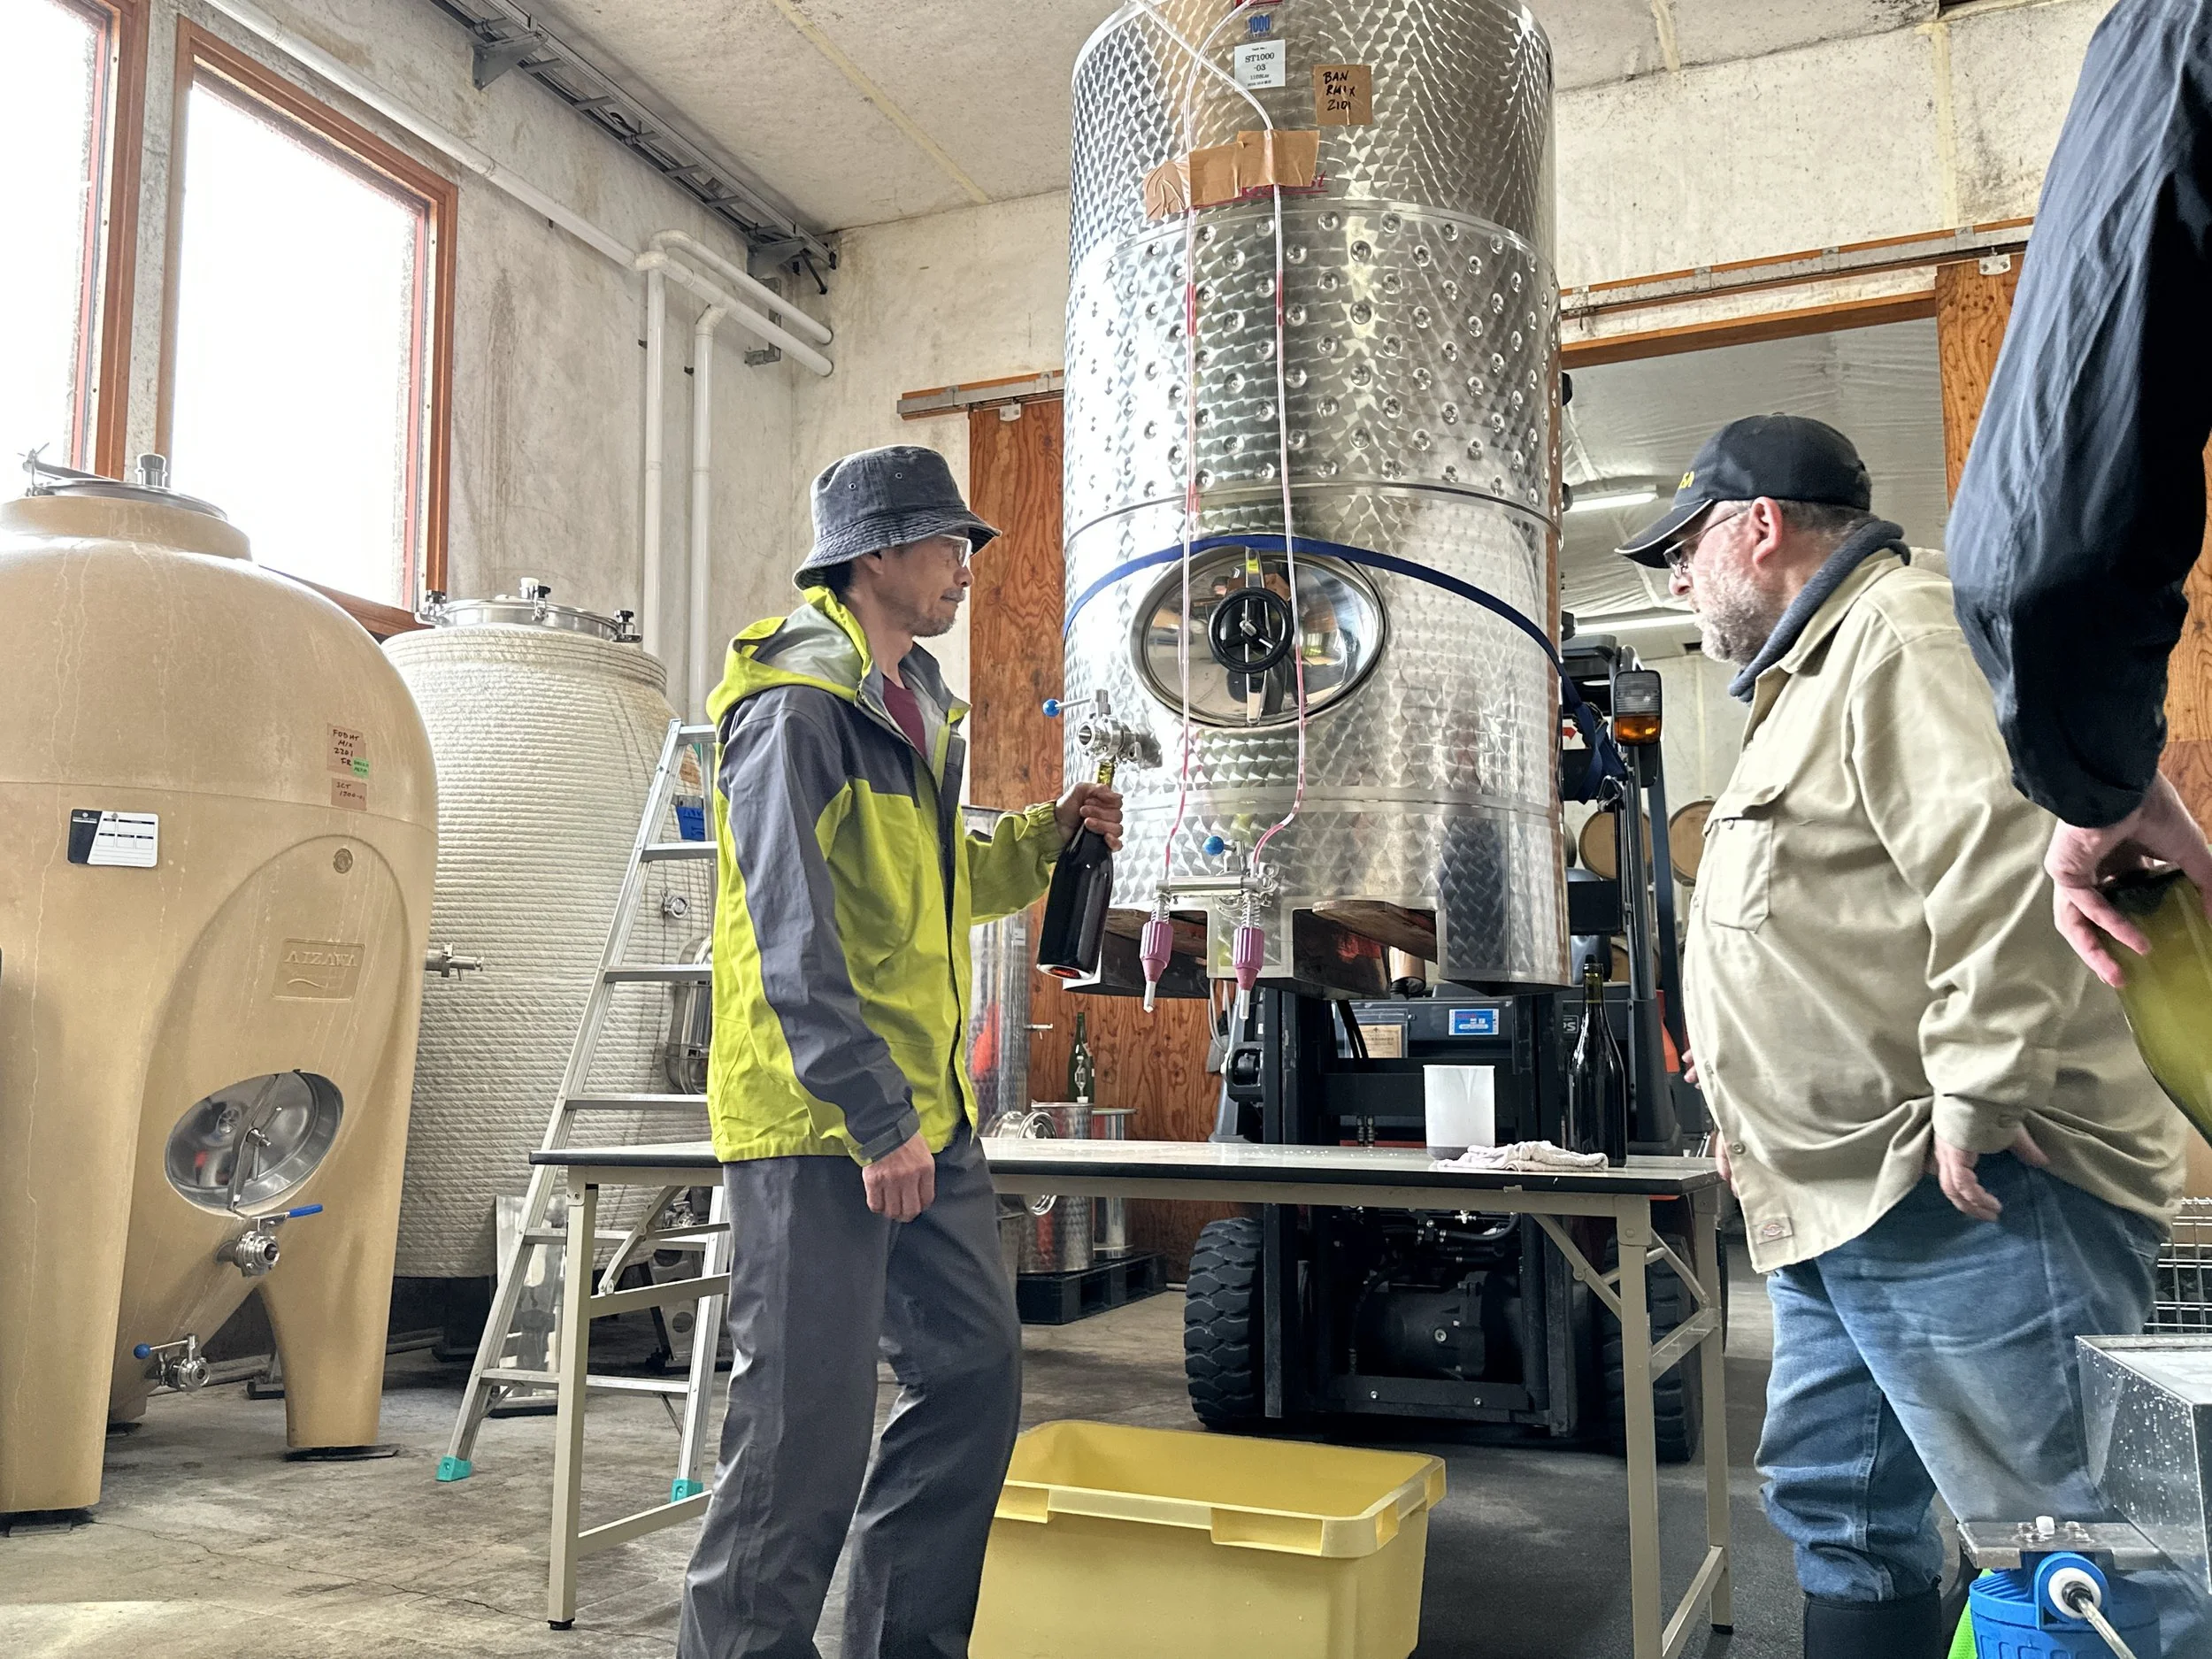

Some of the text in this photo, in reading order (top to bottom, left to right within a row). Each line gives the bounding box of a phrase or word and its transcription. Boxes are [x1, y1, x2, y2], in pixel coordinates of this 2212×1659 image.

[1248, 14, 1271, 34] 1000
[1245, 52, 1275, 63] ST1000
[1323, 70, 1349, 84] BAN
[1327, 99, 1351, 111] 2101
[283, 950, 358, 967] AIZAWA
